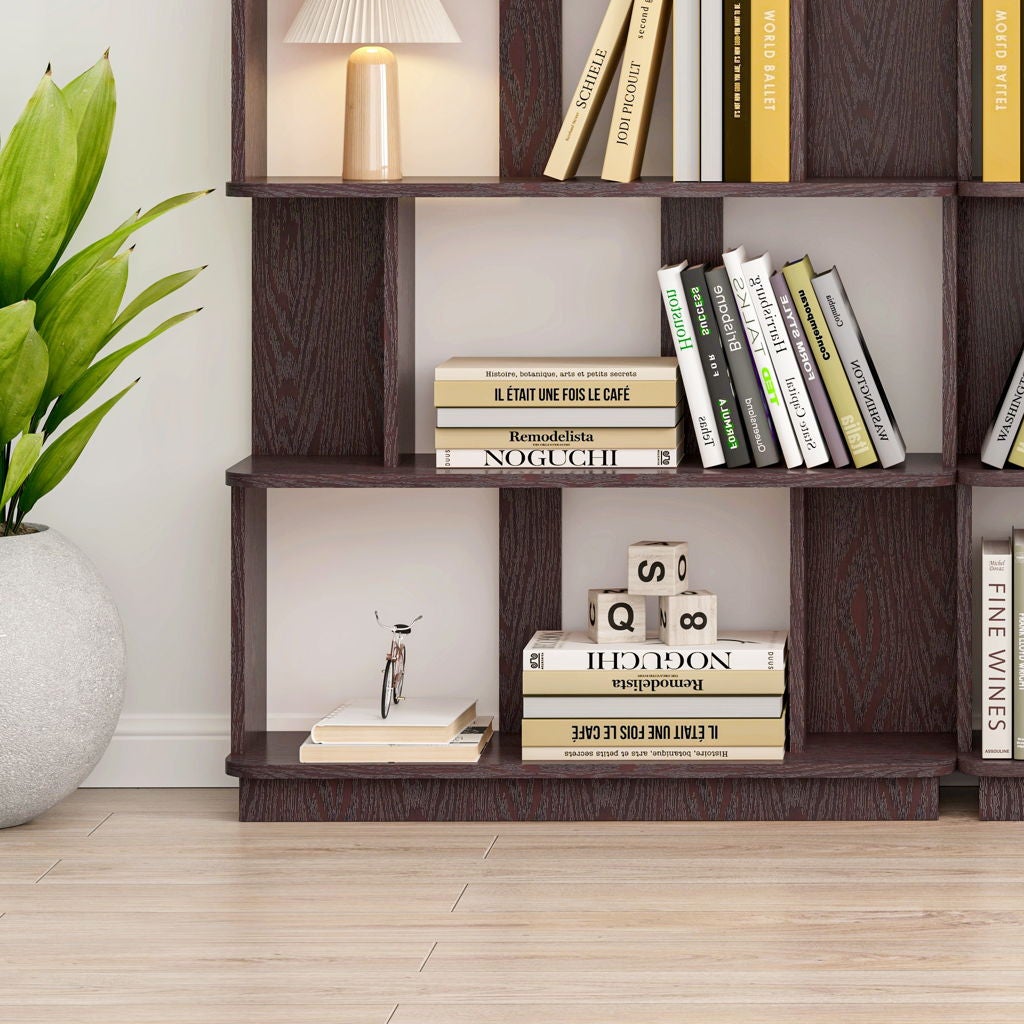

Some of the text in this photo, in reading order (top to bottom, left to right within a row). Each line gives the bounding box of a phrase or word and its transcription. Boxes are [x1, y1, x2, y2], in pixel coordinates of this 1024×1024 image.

[638, 6, 649, 39] second
[764, 10, 776, 111] WORLD BALLET
[576, 48, 607, 109] SCHIELE
[616, 60, 641, 145] JODI PICOULT
[495, 385, 630, 401] IL ÉTAIT UNE FOIS LE CAFÉ
[509, 431, 594, 442] Remodelista
[484, 449, 618, 467] NOGUCHI
[638, 560, 665, 582] S
[608, 602, 634, 632] Q
[680, 612, 707, 630] 8
[587, 652, 731, 670] NOGUCHI
[988, 583, 1006, 730] FINE WINES
[612, 679, 703, 691] Remodelista
[572, 725, 718, 742] IL ÉTAIT UNE FOIS LE CAFÉ
